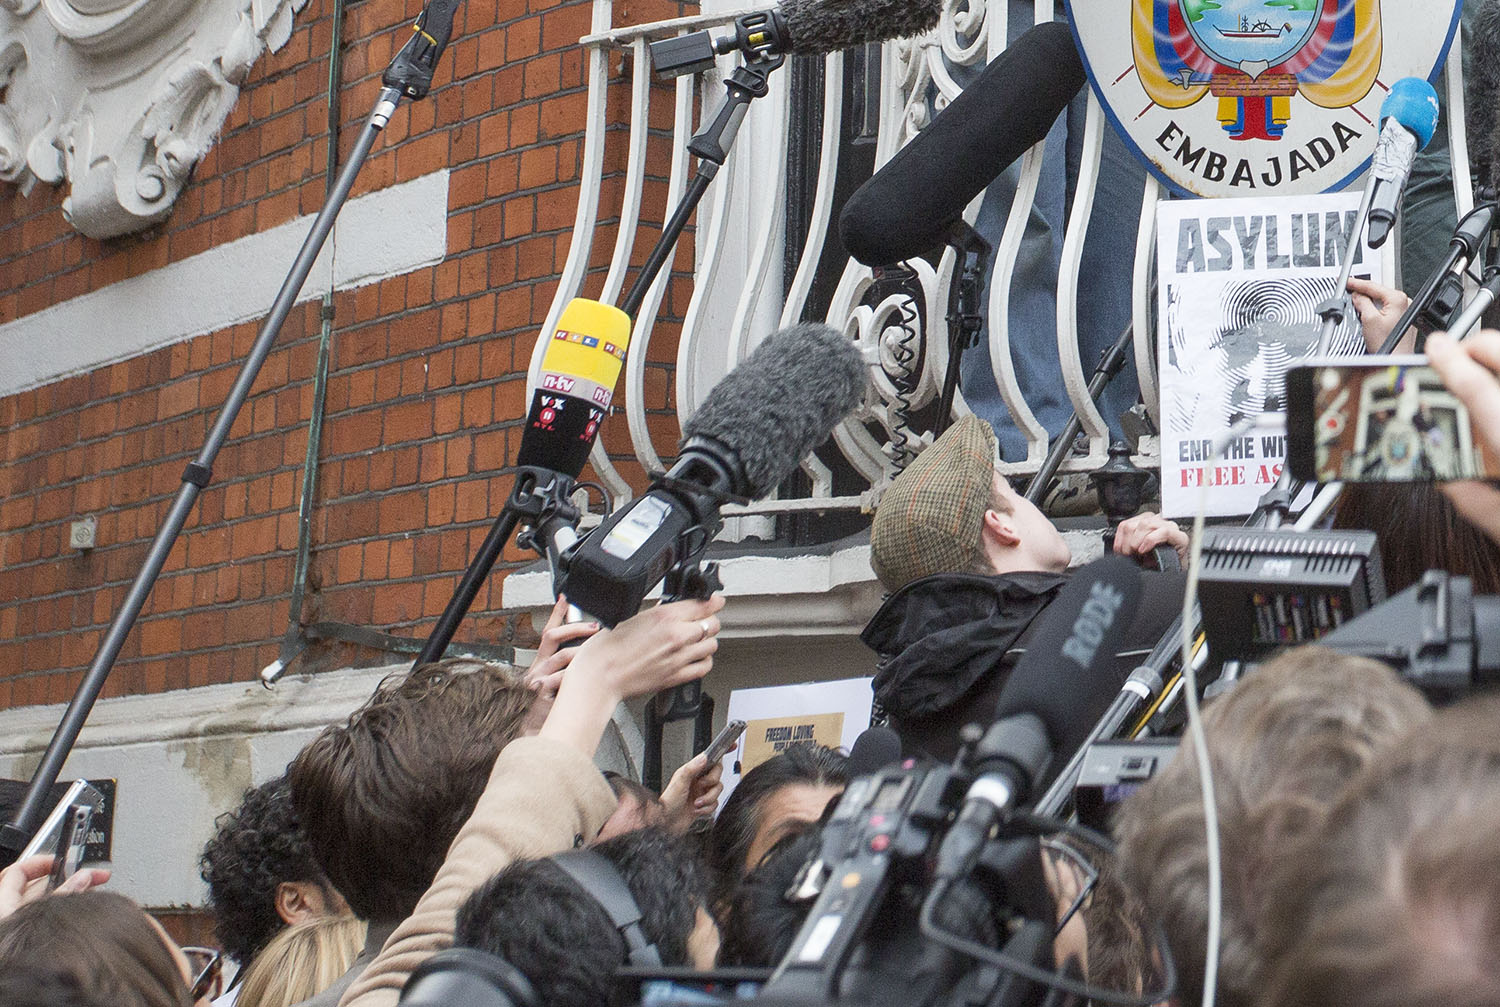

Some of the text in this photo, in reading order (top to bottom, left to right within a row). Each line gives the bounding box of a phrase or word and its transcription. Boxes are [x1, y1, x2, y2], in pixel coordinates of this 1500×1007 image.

[1155, 120, 1362, 188] EMBAJADA
[1176, 210, 1363, 273] ASYLUM
[555, 331, 597, 347] RTL
[544, 376, 574, 392] n-tv
[1180, 465, 1246, 487] FREE
[765, 724, 815, 743] FREEDOM LOVING
